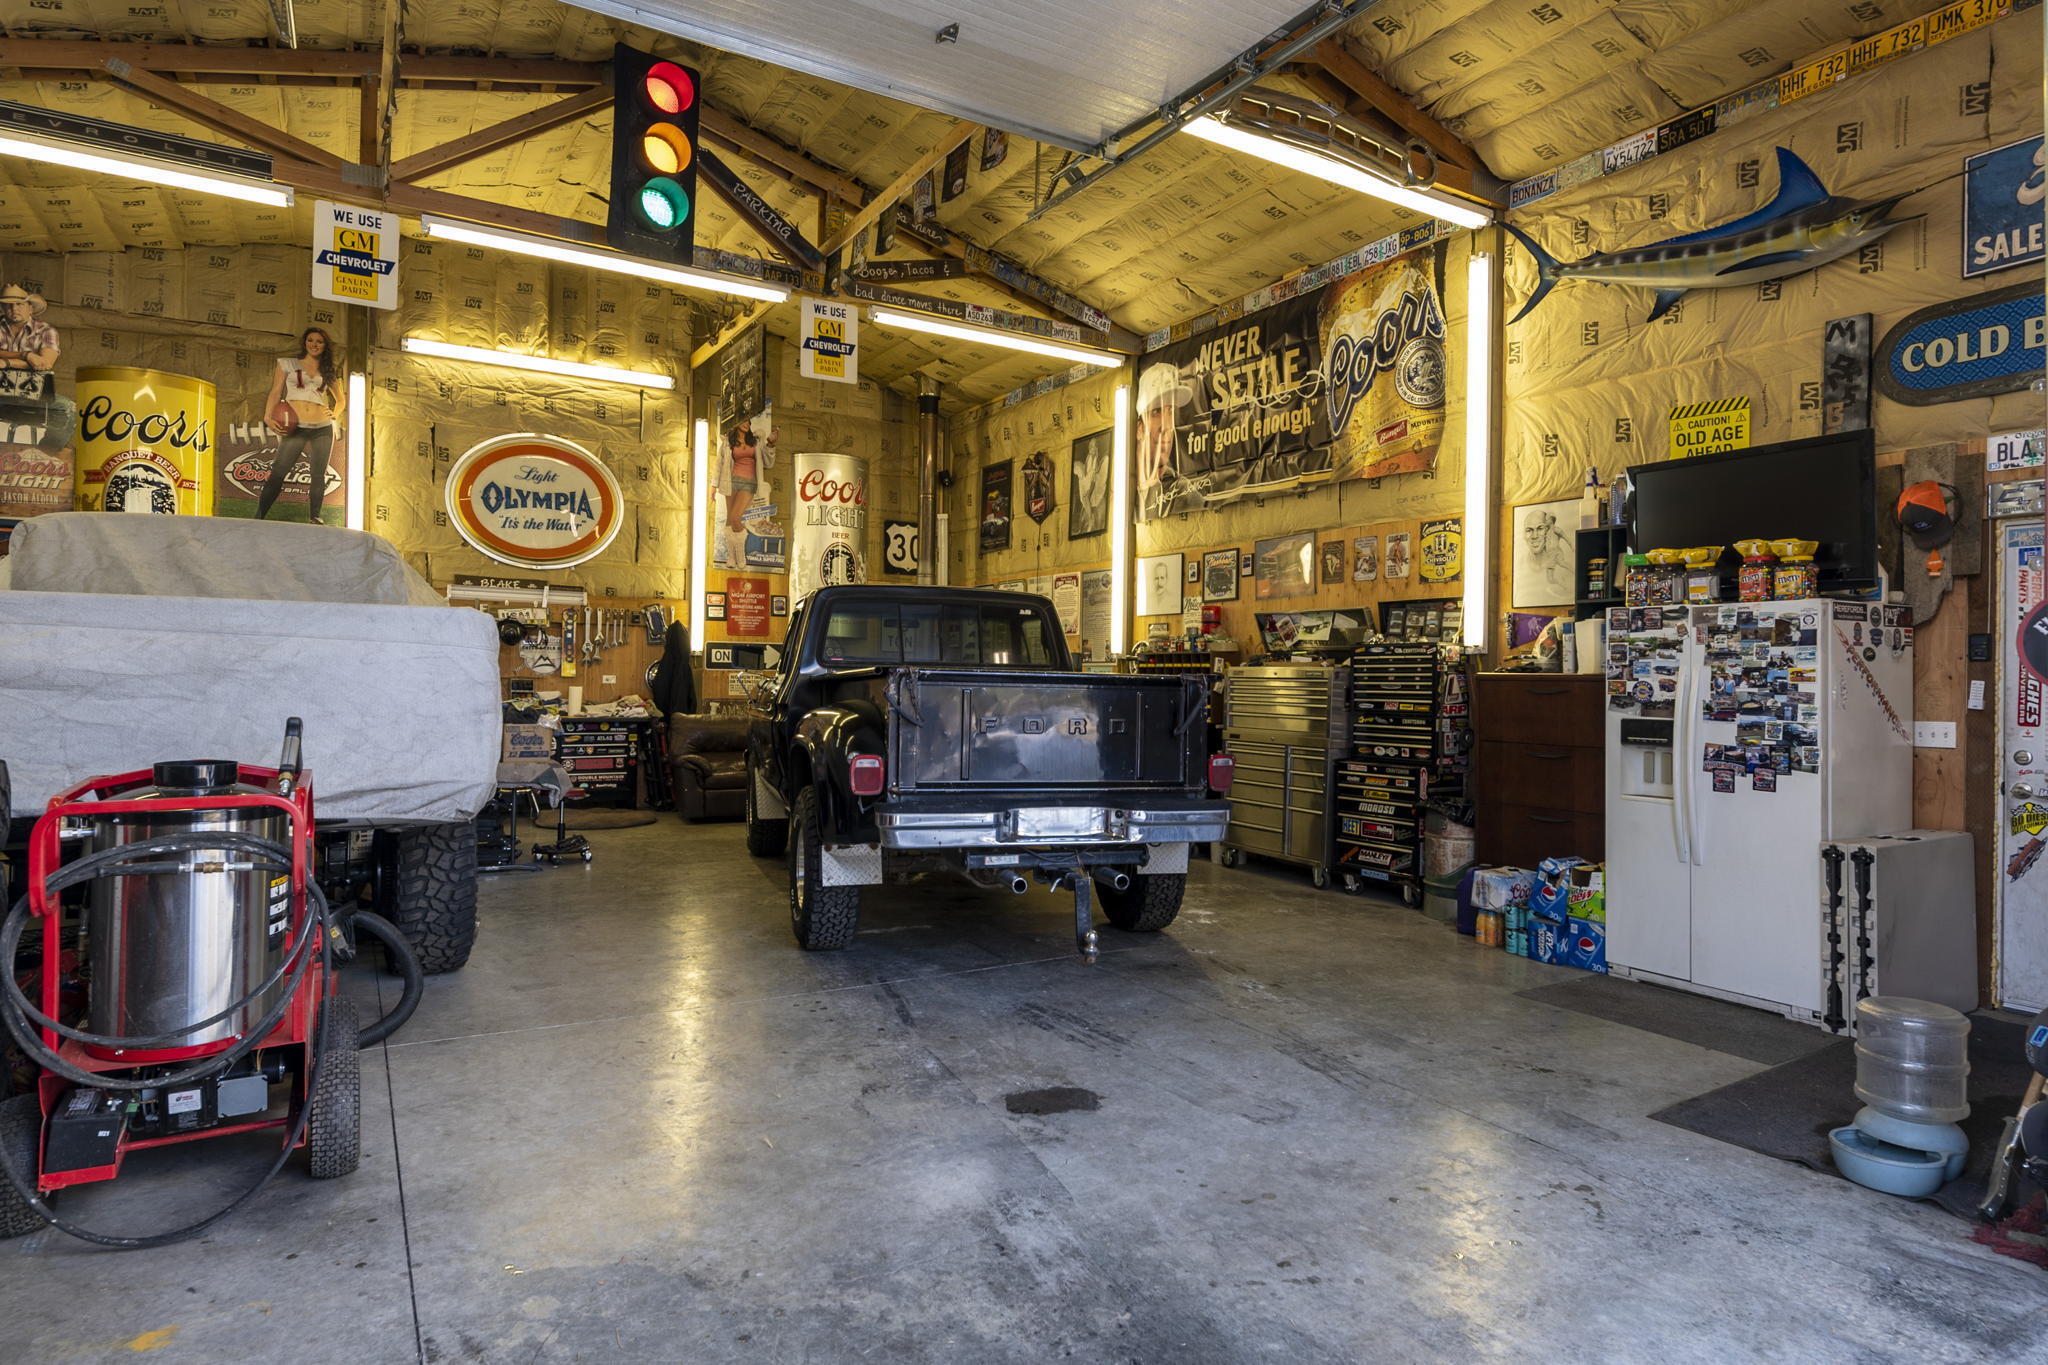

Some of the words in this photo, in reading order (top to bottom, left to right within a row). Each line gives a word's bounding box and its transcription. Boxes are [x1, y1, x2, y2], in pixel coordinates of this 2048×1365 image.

[1930, 6, 1965, 35] JMK
[1853, 39, 1881, 66] HHF
[1890, 24, 1921, 51] 732
[1782, 70, 1809, 95] HHF
[1817, 55, 1844, 81] 732
[1795, 79, 1831, 97] OREGON
[1660, 129, 1686, 150] SRA
[1690, 117, 1713, 137] 507
[1512, 179, 1554, 204] BONANZA
[333, 209, 354, 224] WE
[358, 214, 382, 229] USE
[733, 183, 792, 239] PARKING
[339, 230, 375, 251] GM
[1364, 248, 1379, 262] 258
[1383, 239, 1398, 256] JXG
[326, 253, 387, 273] CHEVROLET
[904, 262, 935, 275] Tacos
[1331, 263, 1344, 278] 881
[336, 276, 374, 288] GENUINE
[341, 285, 369, 295] PARTS
[855, 284, 875, 300] bad
[881, 290, 908, 305] dance
[908, 298, 933, 311] moves
[937, 302, 963, 316] there
[813, 304, 828, 315] WE
[830, 307, 847, 318] USE
[817, 321, 842, 336] GM
[809, 340, 851, 353] CHEVROLET
[1197, 325, 1261, 373] NEVER
[1902, 324, 2011, 372] COLD
[1326, 287, 1447, 437] Coors
[1211, 348, 1301, 411] SETTLE
[79, 395, 211, 452] Coors
[1688, 414, 1731, 429] CAUTION!
[1187, 431, 1209, 455] for
[1211, 420, 1249, 453] "good
[1378, 421, 1406, 444] Banquet
[1675, 429, 1706, 447] OLD
[1711, 425, 1744, 442] AGE
[1686, 442, 1734, 457] AHEAD
[103, 450, 154, 473] BANQUET
[153, 456, 181, 480] BEER
[233, 462, 272, 482] Coo
[514, 465, 561, 484] Light
[0, 474, 65, 489] LIGHT
[480, 480, 595, 521] OLYMPIA
[523, 517, 543, 530] the
[480, 579, 521, 590] BLAKE
[714, 650, 731, 662] ON
[1442, 705, 1467, 715] ARP
[978, 716, 1129, 736] FORD
[1359, 802, 1396, 815] MOROSO
[1511, 883, 1531, 899] Coo
